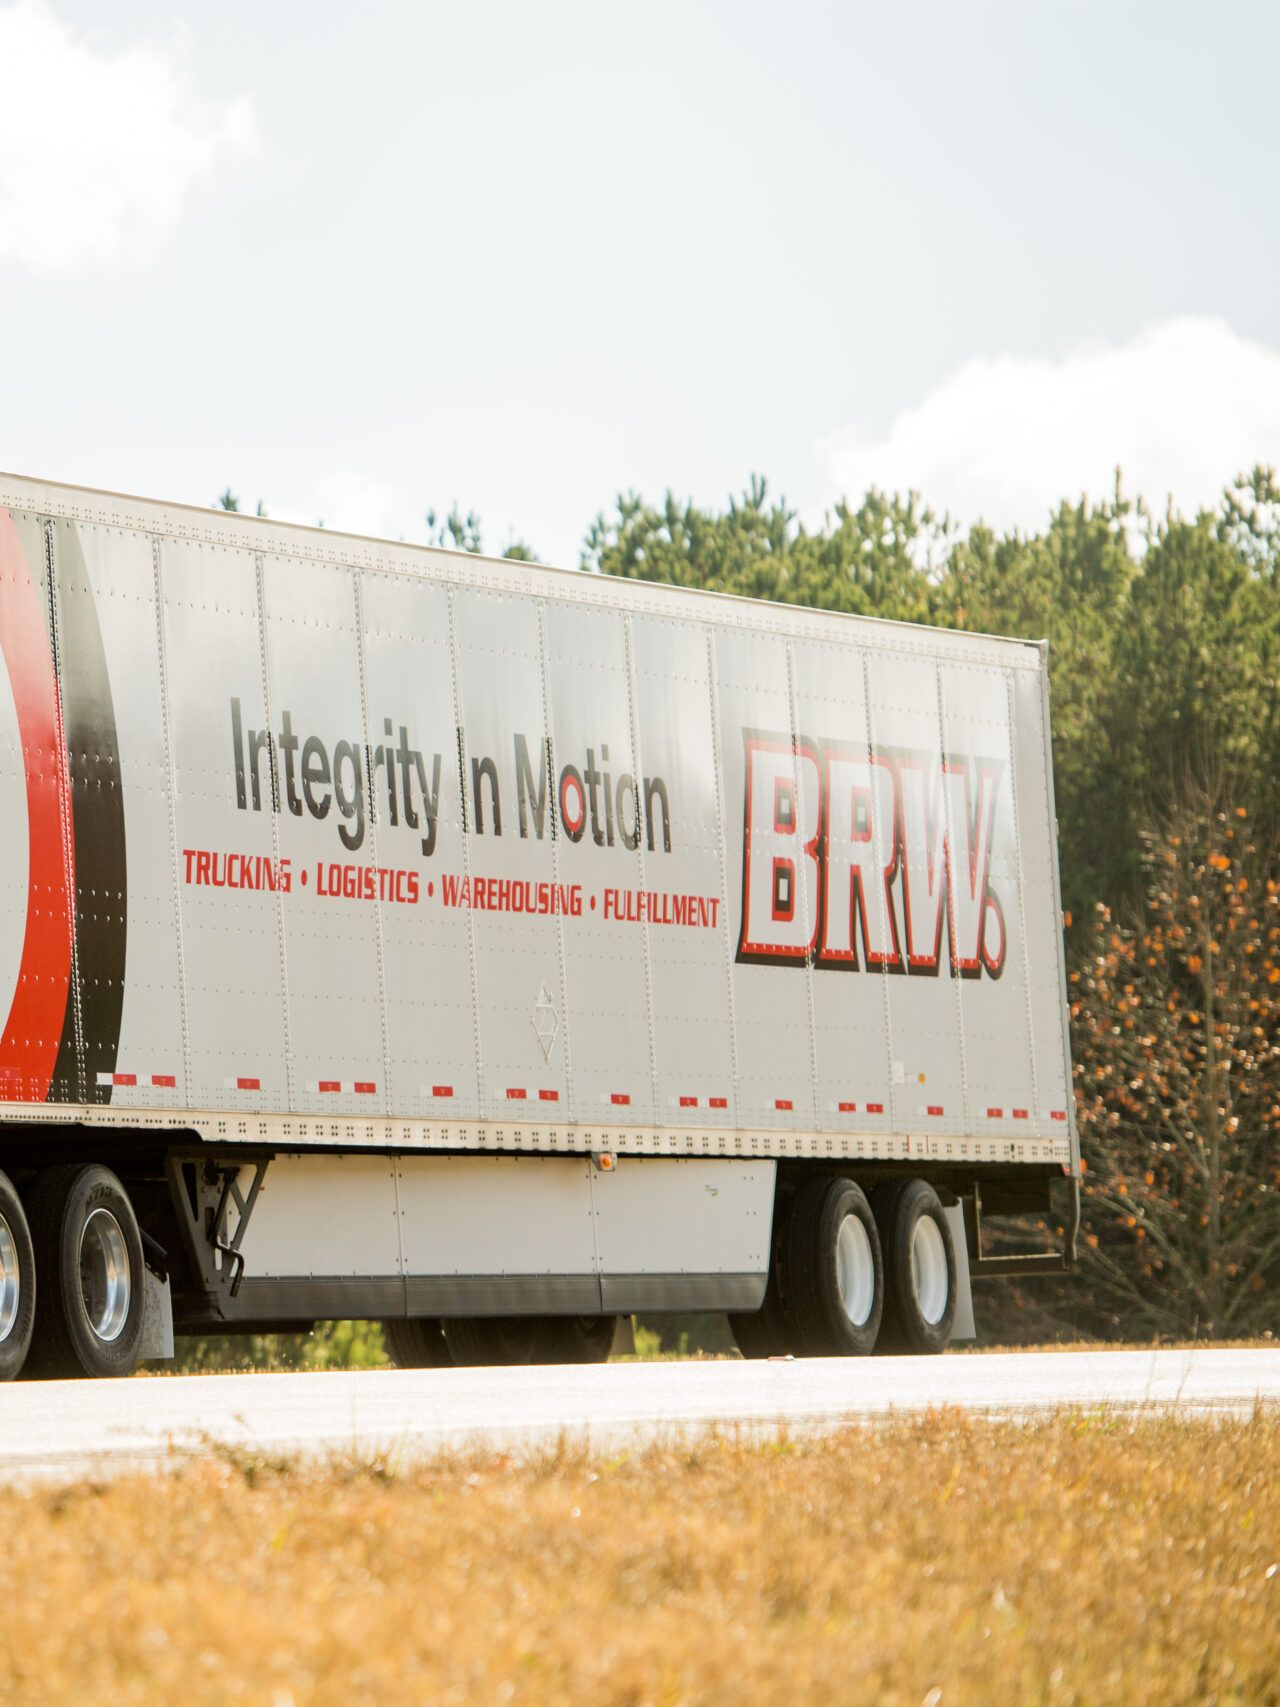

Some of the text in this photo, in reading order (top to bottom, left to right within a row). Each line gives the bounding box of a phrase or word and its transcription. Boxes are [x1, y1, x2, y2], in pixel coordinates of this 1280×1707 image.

[230, 696, 442, 857] Integrity
[513, 732, 672, 853] Motion
[183, 849, 720, 928] TRUCKING LOGISTICS WAREHOUSING FULFILLMENT
